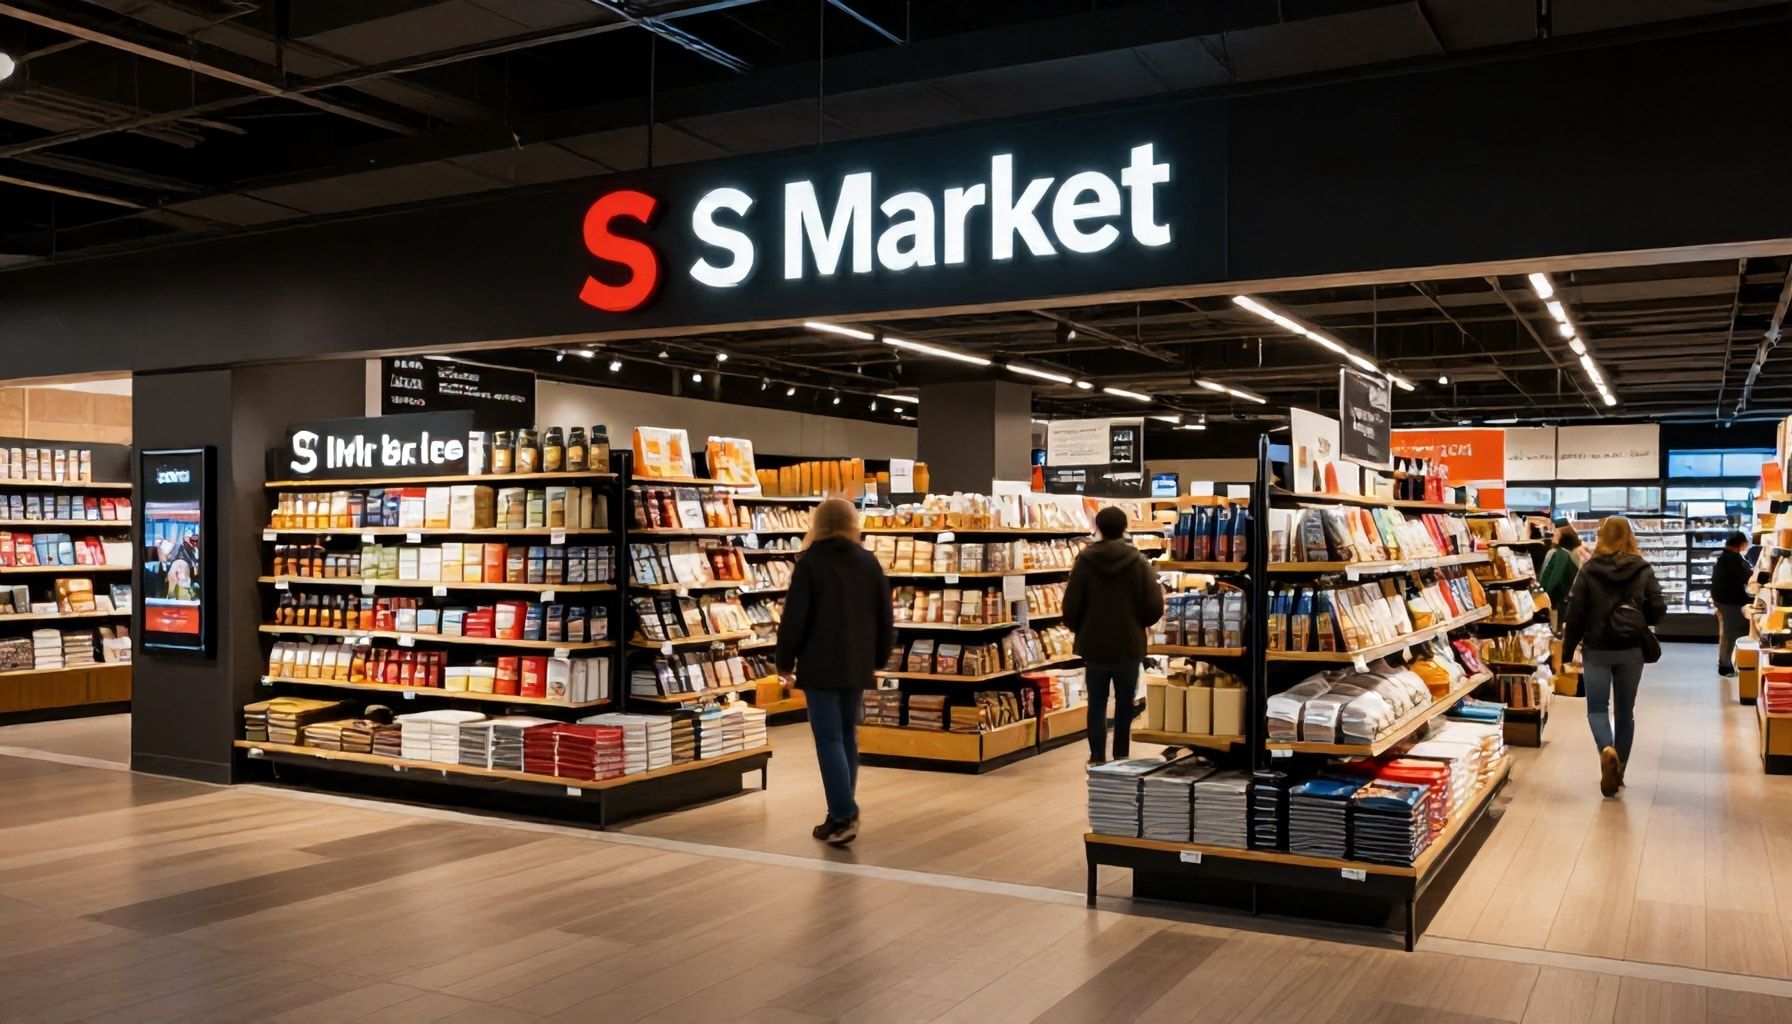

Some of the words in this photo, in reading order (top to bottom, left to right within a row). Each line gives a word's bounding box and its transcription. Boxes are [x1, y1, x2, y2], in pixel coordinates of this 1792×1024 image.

[579, 190, 659, 312] S
[689, 187, 756, 288] S
[784, 142, 1172, 280] Market
